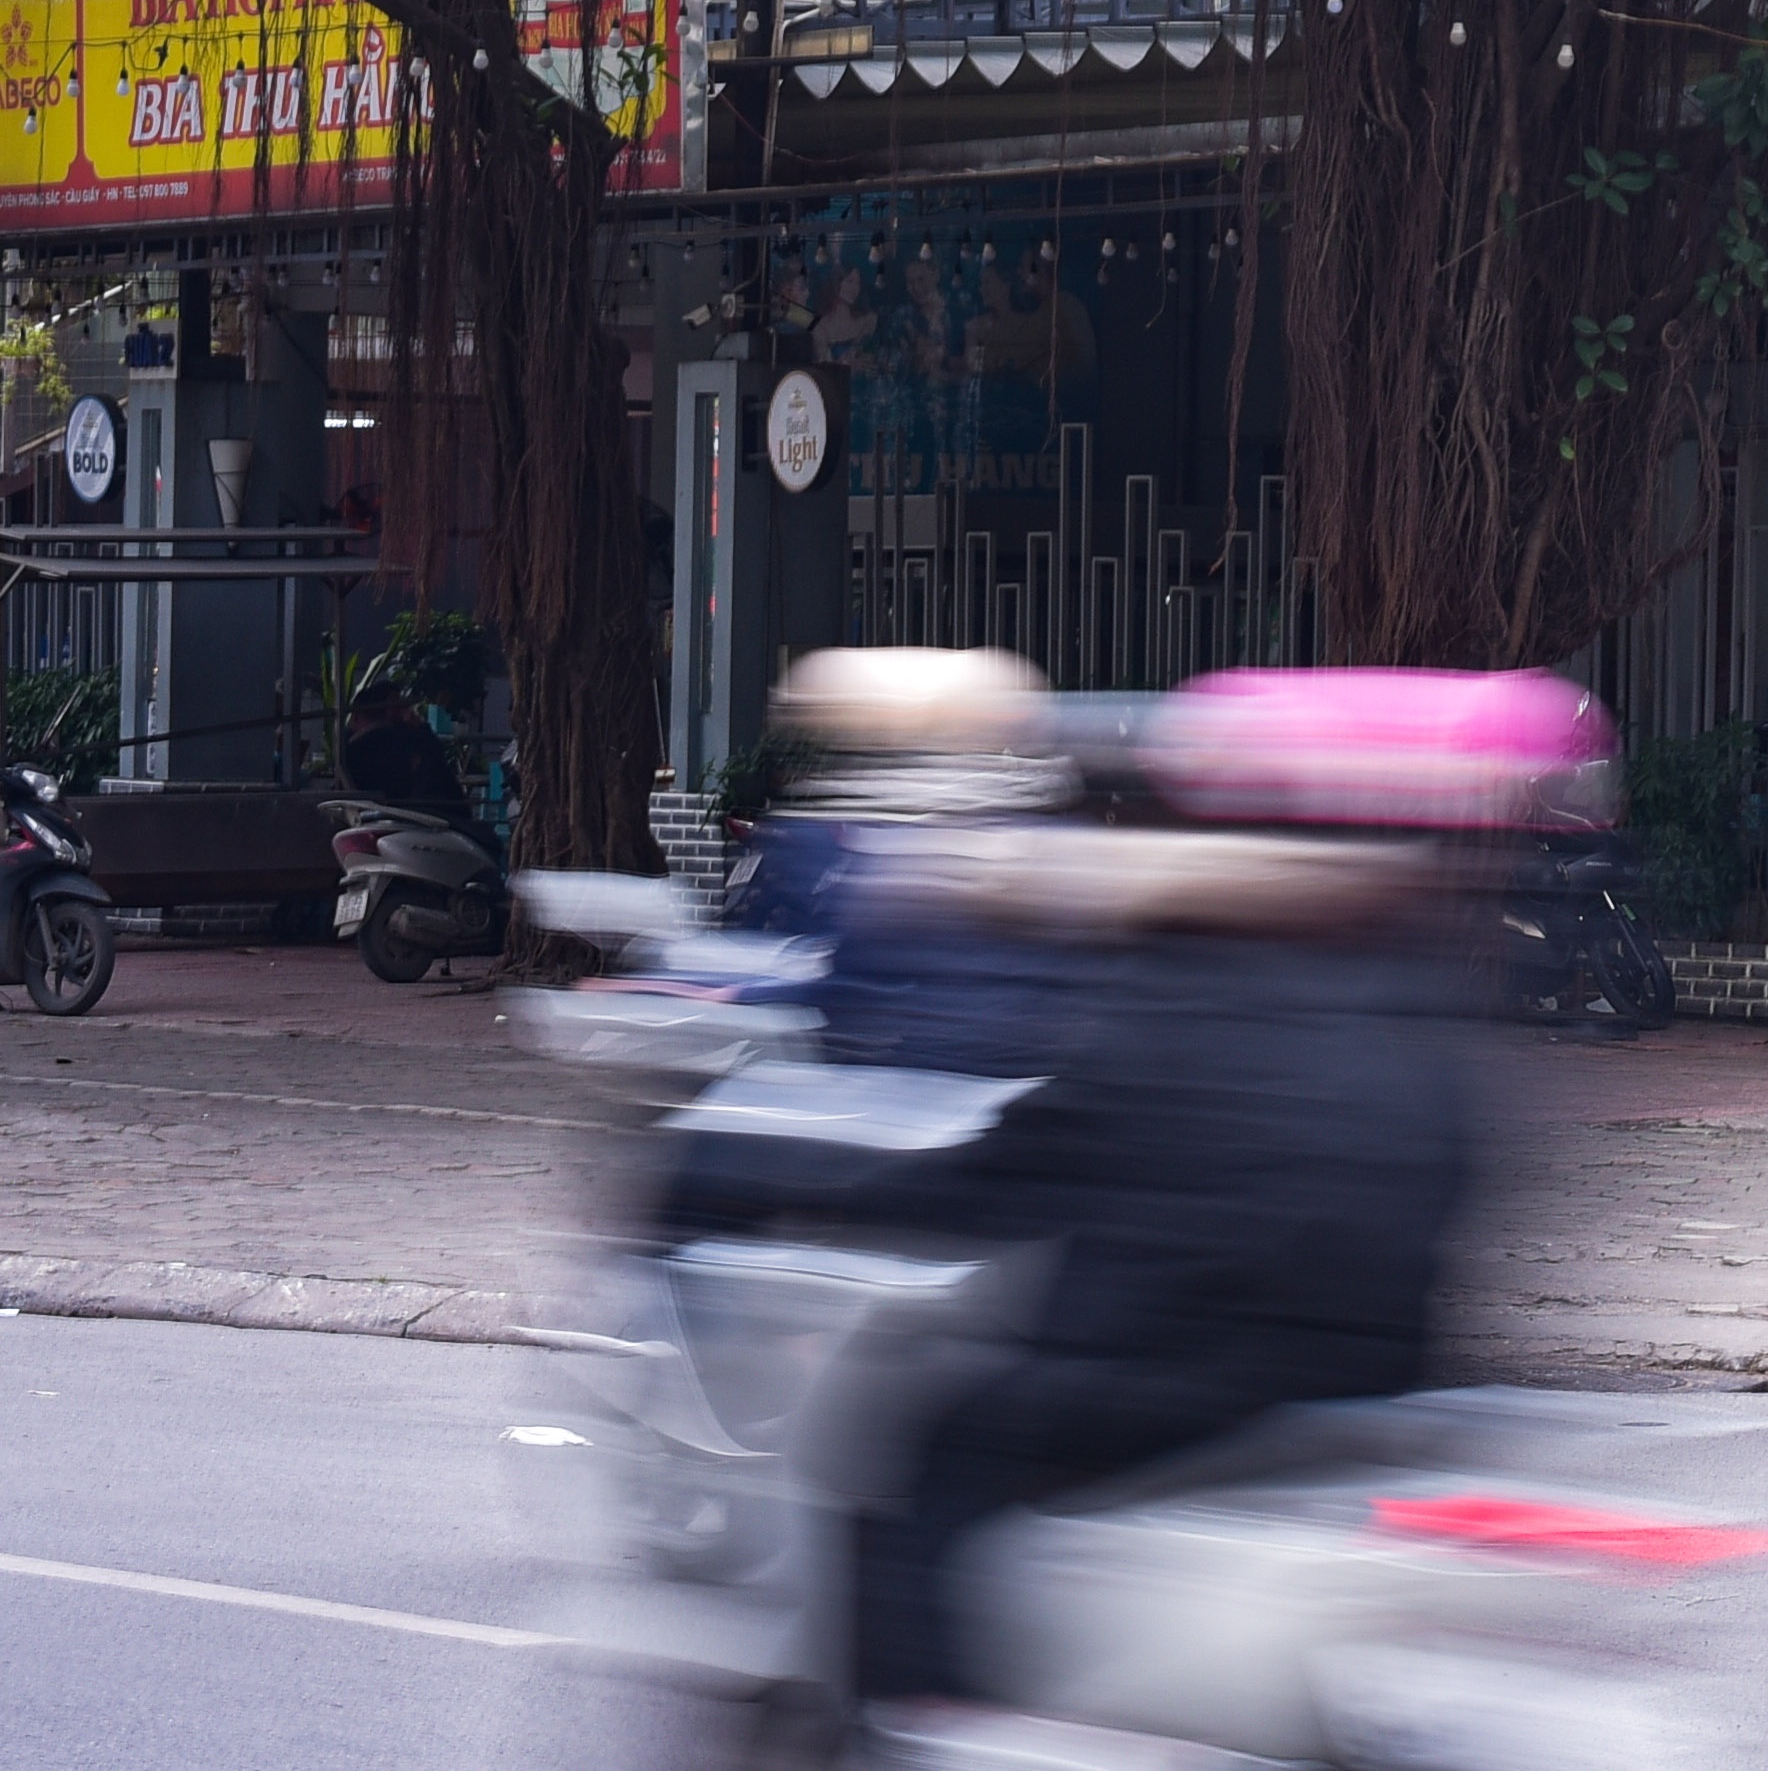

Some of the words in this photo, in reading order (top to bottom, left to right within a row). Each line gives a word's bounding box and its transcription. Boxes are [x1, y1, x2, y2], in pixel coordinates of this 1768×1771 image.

[129, 74, 206, 147] BIA
[220, 66, 300, 138] THU
[73, 452, 109, 474] BOLD
[779, 436, 818, 473] Light
